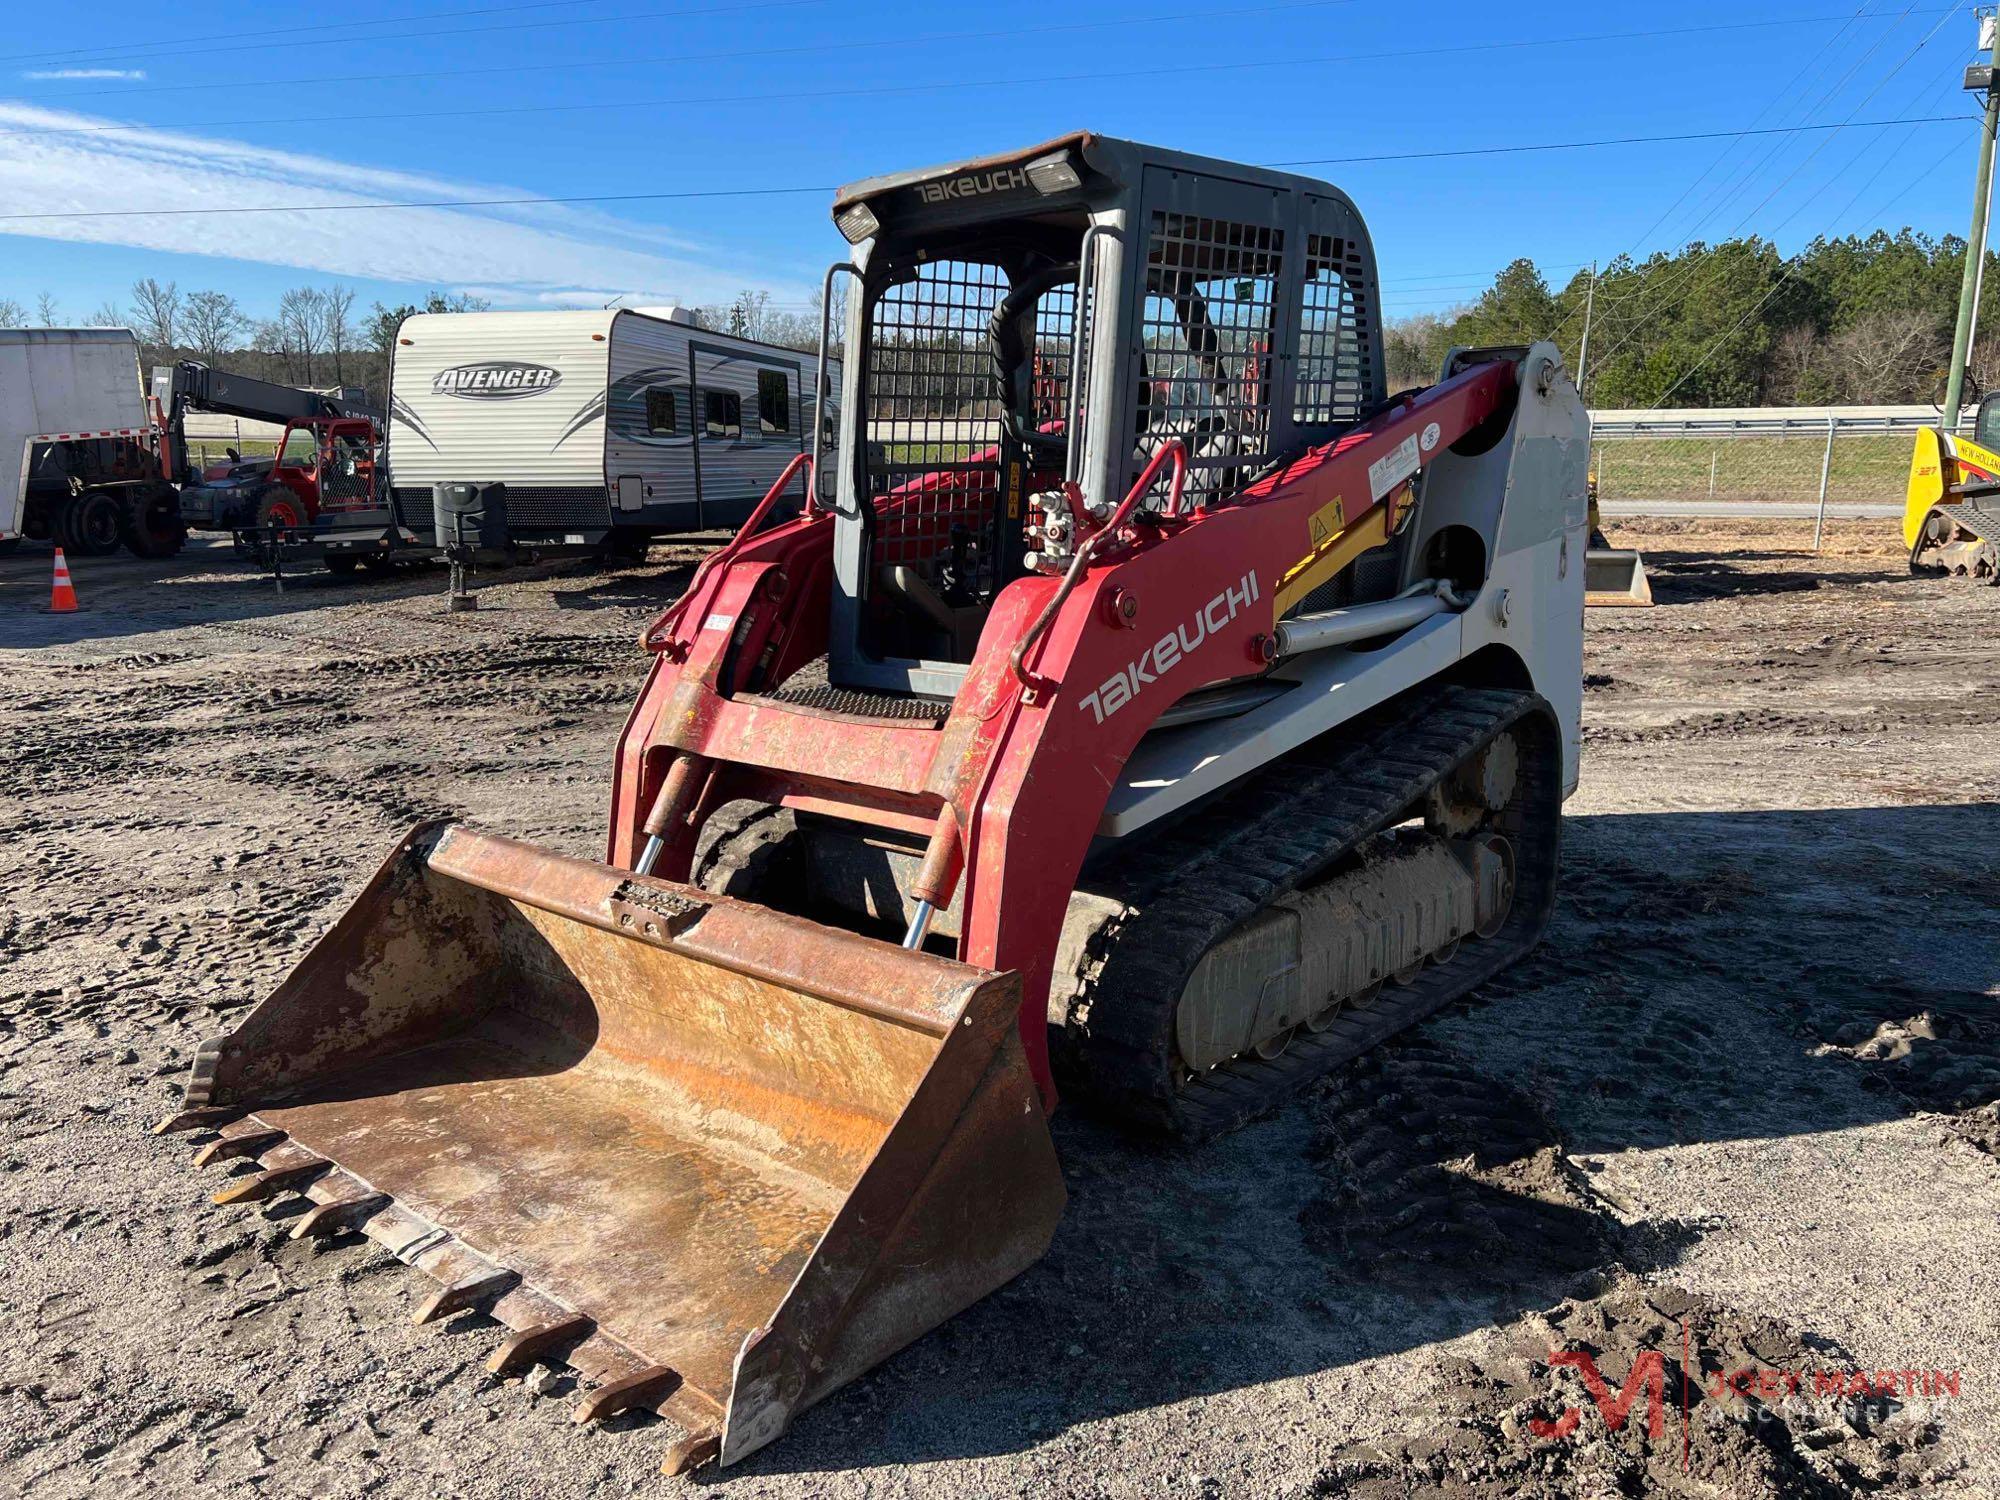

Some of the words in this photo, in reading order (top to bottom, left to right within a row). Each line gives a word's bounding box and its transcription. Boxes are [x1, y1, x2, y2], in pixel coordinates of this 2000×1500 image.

[915, 168, 1028, 203] TAKEUCH
[432, 369, 554, 394] AVENGER
[1961, 444, 1974, 459] NEW
[1975, 452, 2000, 470] HOLLAN
[1079, 569, 1260, 725] TAKEUCHI
